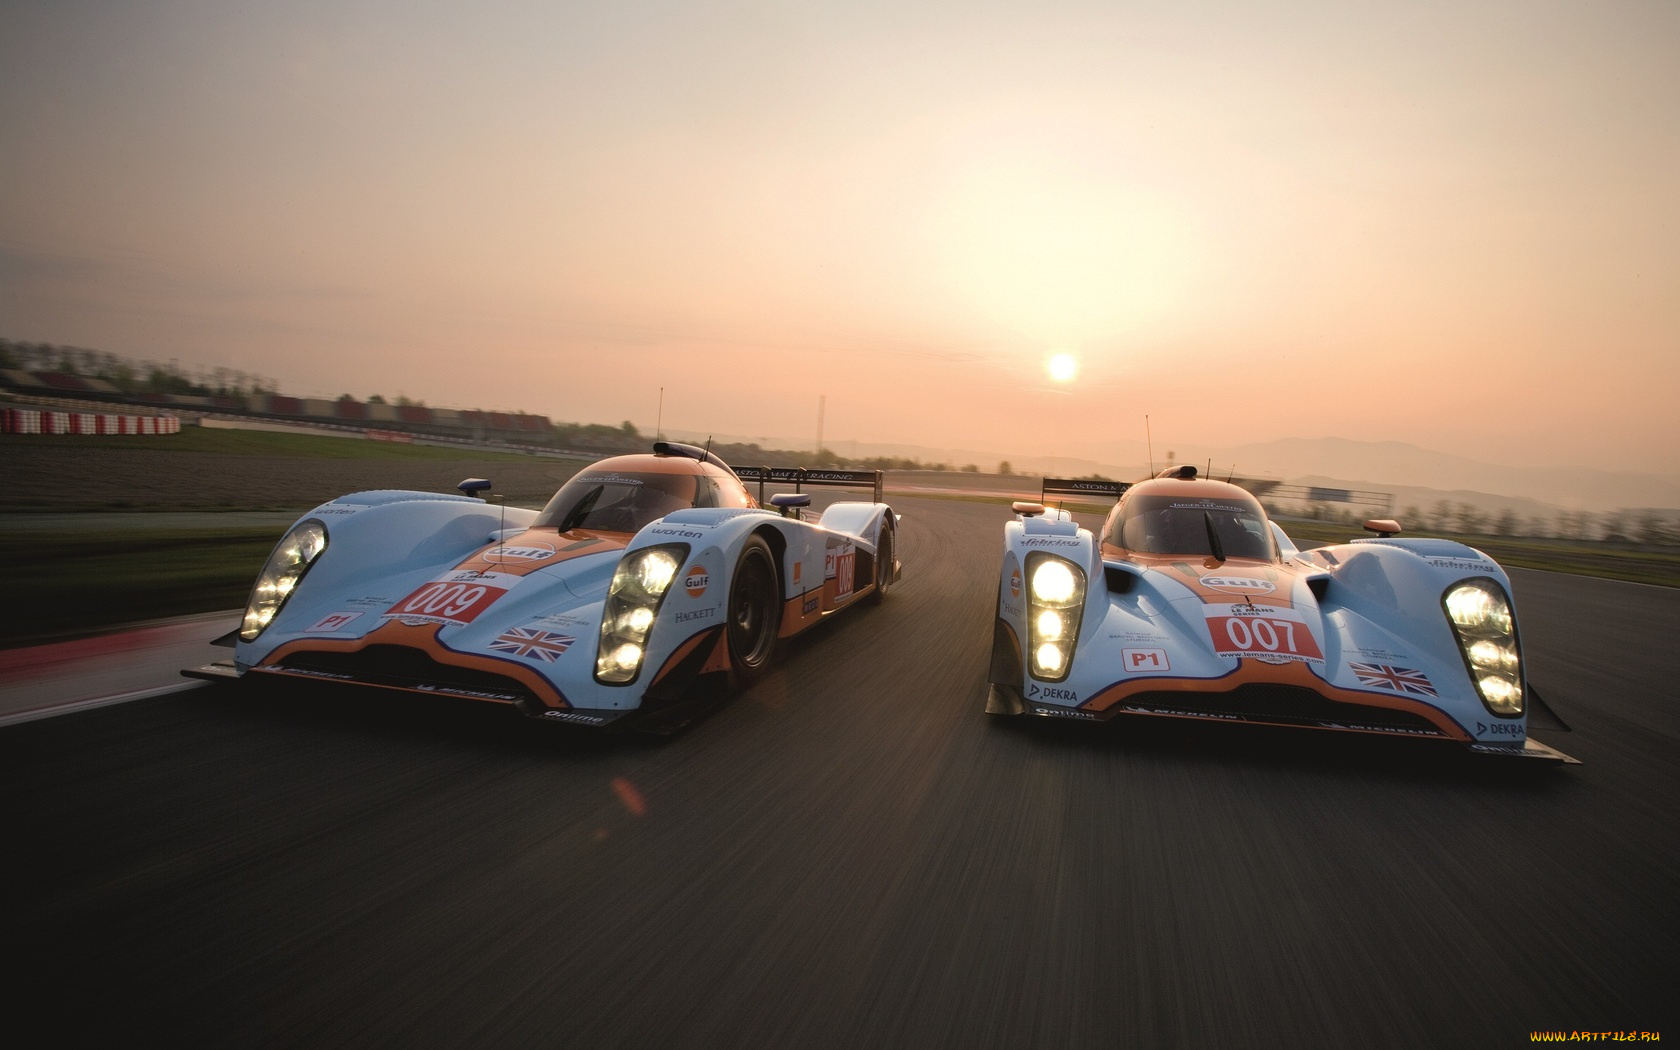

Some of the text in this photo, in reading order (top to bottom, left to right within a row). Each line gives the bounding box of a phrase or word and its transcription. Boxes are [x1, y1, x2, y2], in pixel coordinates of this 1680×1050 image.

[809, 472, 854, 481] RACING
[651, 527, 703, 539] worten
[490, 546, 555, 559] Gulf
[825, 554, 836, 571] P1
[684, 575, 710, 588] Gulf
[1200, 577, 1275, 590] Gulf
[403, 583, 487, 617] 009
[316, 615, 353, 628] P1
[674, 607, 716, 624] HACKETT
[1225, 617, 1298, 653] 007
[1131, 652, 1160, 667] P1
[1219, 651, 1326, 666] www.lemans-series.com
[1043, 687, 1078, 702] DEKRA
[544, 710, 604, 723] Ontime
[1153, 709, 1239, 720] MICHELIN
[1350, 724, 1439, 736] MICHELIN
[1490, 723, 1525, 735] DEKRA
